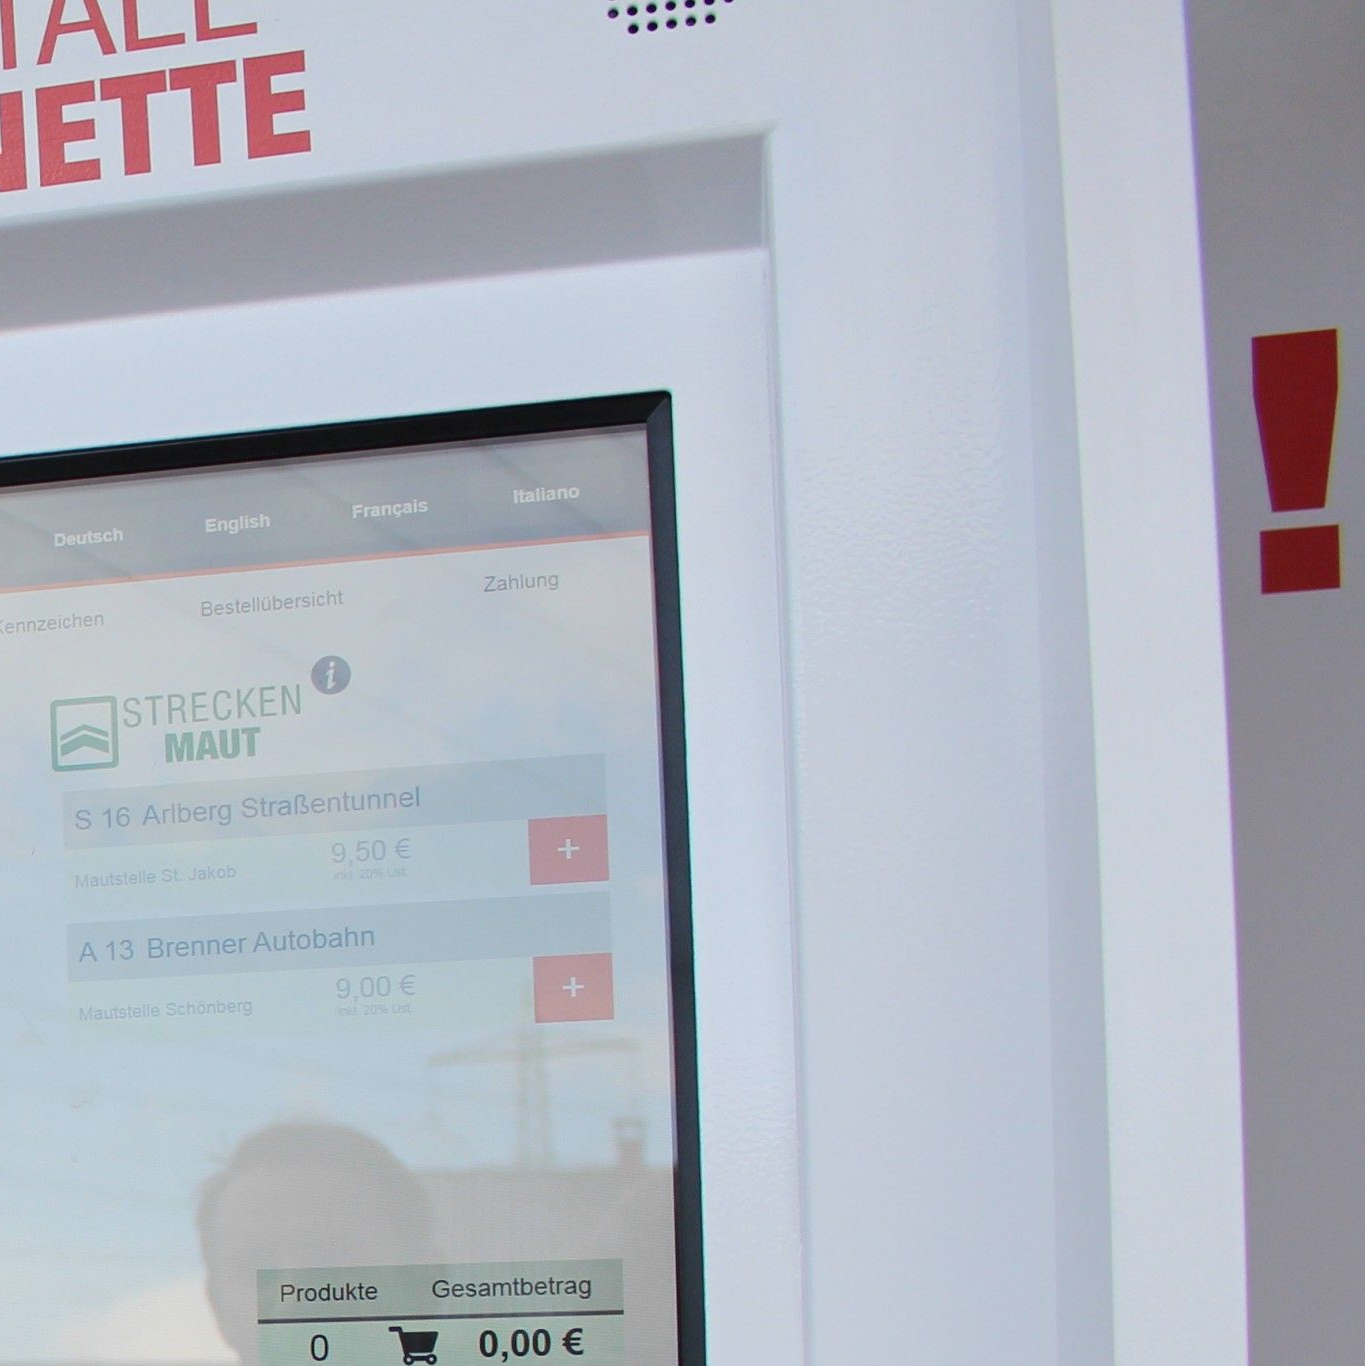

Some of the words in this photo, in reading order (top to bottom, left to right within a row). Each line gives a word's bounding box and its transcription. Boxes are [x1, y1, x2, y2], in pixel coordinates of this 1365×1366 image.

[54, 528, 124, 547] Deutsch
[205, 514, 270, 534] English
[351, 498, 429, 519] Français
[512, 486, 580, 504] Italiano
[201, 590, 344, 617] Bestellübersicht
[483, 574, 559, 593] Zahlung
[122, 683, 301, 728] STRECKEN
[164, 726, 261, 763] MAUT
[75, 809, 91, 831] S
[102, 806, 130, 828] 16
[142, 801, 232, 827] Arlberg
[241, 786, 421, 819] Straßentunnel
[332, 839, 387, 867] 9,50
[394, 838, 412, 860] €
[75, 869, 156, 889] Mautstelle
[187, 863, 237, 882] Jakob
[79, 940, 98, 963] A
[105, 938, 134, 961] 13
[147, 936, 247, 959] Brenner
[252, 926, 375, 954] Autobahn
[335, 975, 390, 1003] 9,00
[398, 974, 417, 996] €
[79, 1003, 160, 1021] Mautstelle
[166, 998, 253, 1018] Schönberg
[280, 1282, 378, 1303] Produkte
[431, 1277, 592, 1300] Gesamtbetrag
[310, 1333, 330, 1362] 0
[478, 1328, 551, 1363] 0,00
[561, 1327, 585, 1356] €
